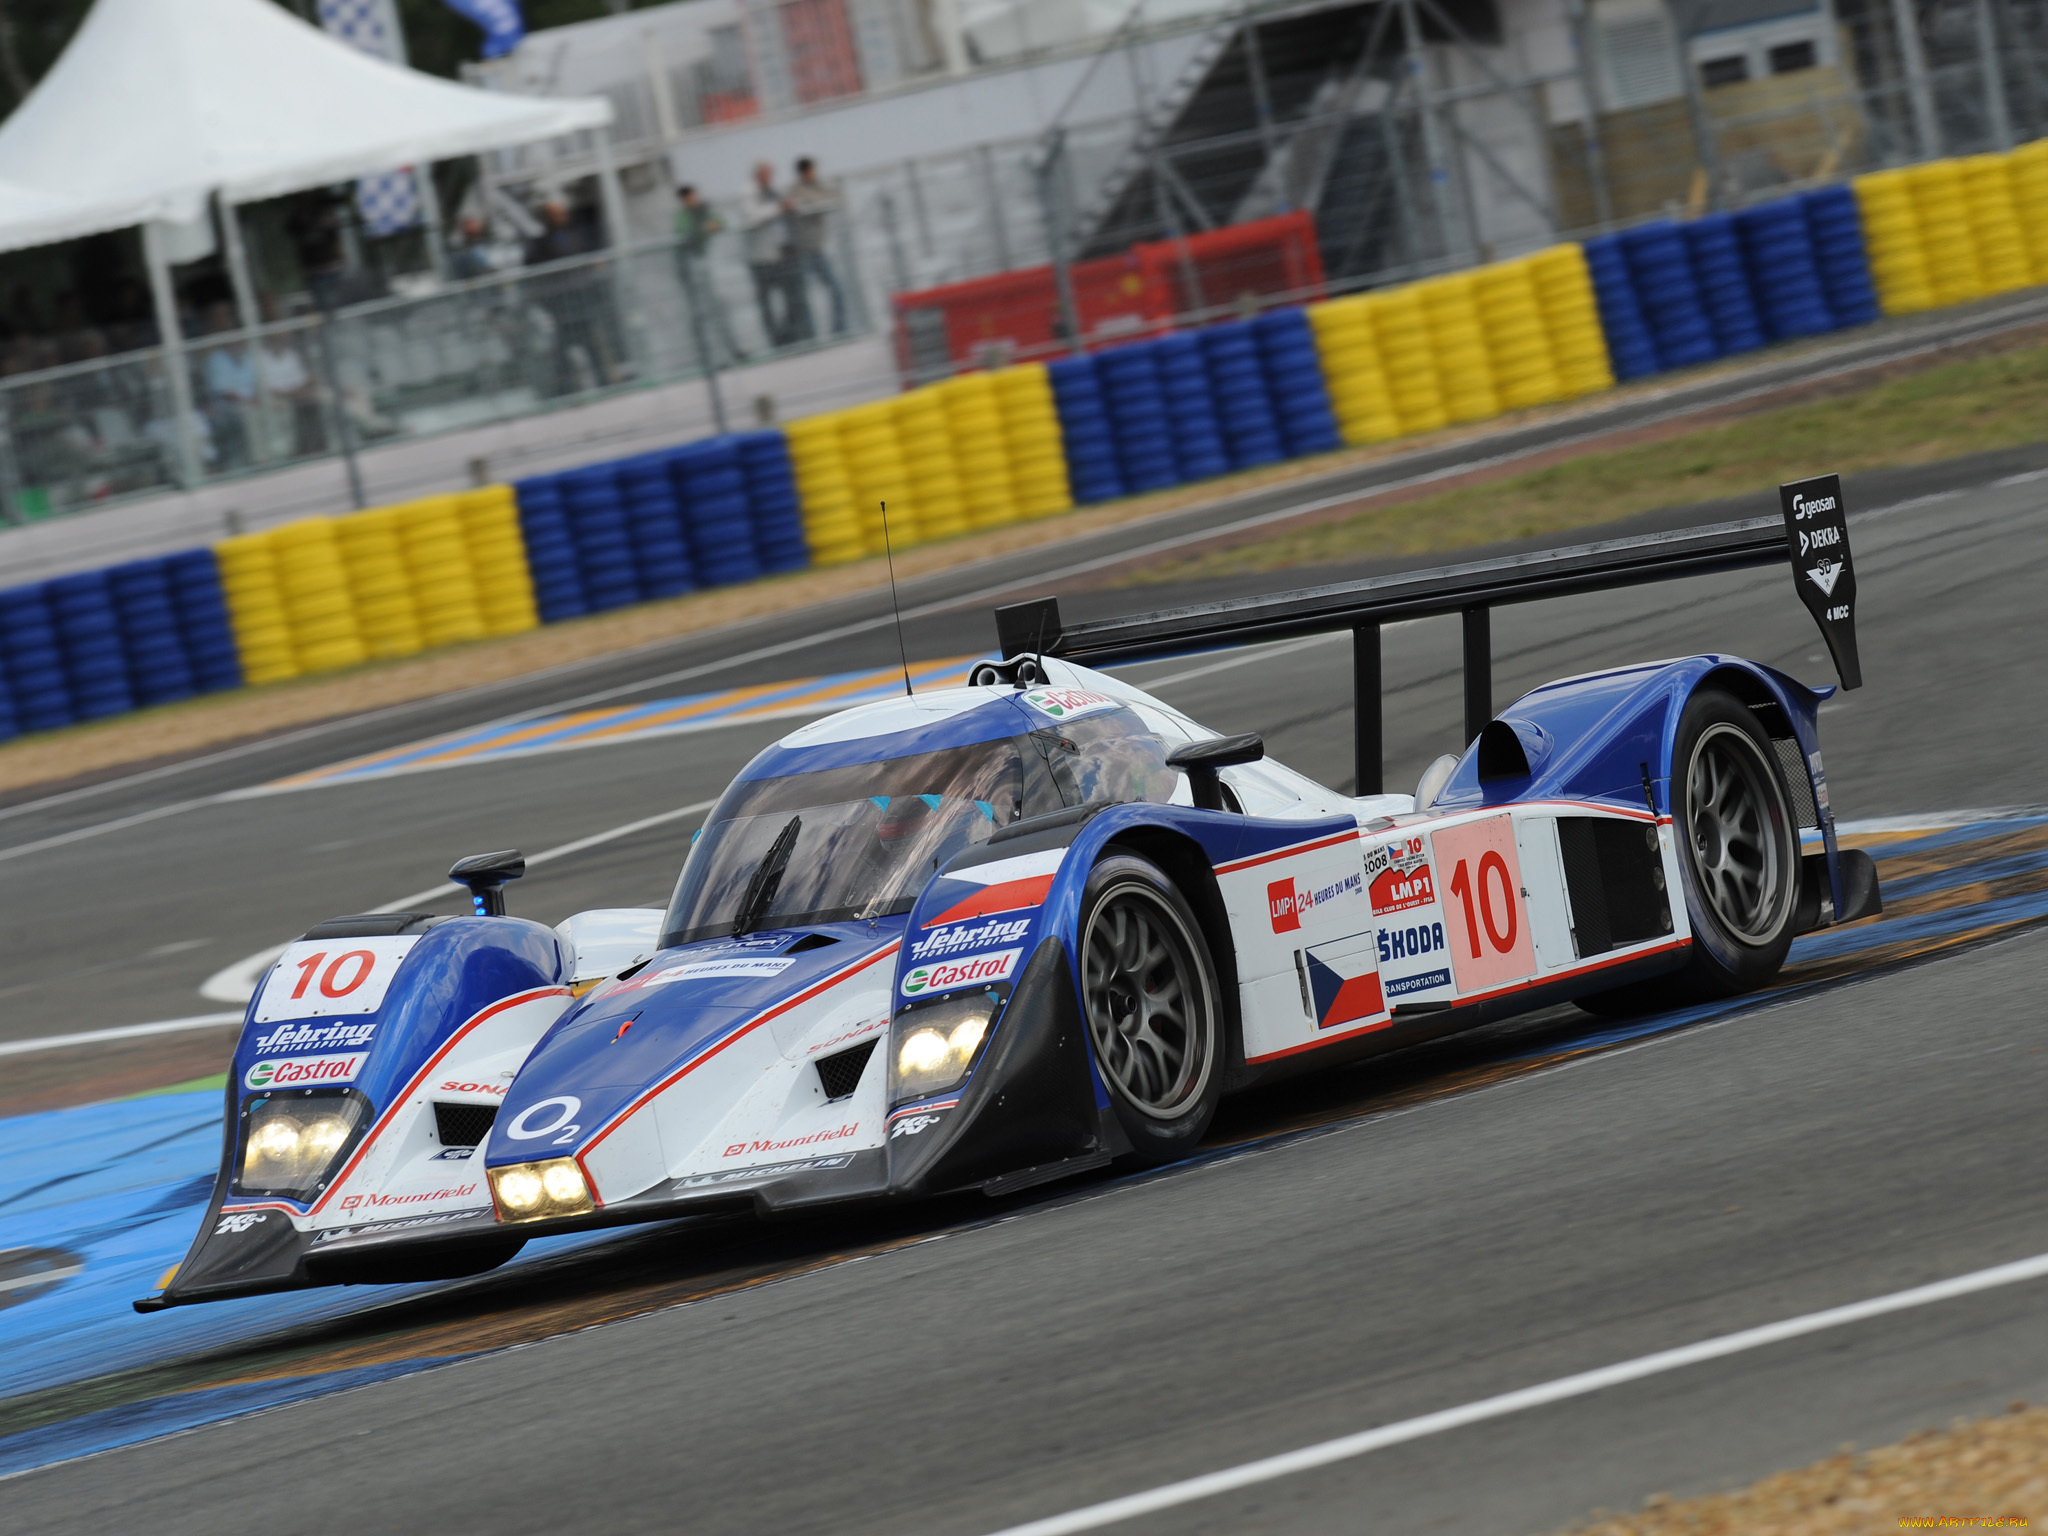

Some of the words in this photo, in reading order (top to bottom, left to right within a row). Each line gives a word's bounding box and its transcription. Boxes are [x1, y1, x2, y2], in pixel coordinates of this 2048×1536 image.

[1806, 496, 1836, 519] geosan
[1810, 526, 1840, 549] DEKRA
[1817, 558, 1832, 576] SD
[1826, 608, 1832, 621] 4
[1833, 605, 1849, 620] MCC
[1374, 846, 1385, 855] MANS
[1407, 837, 1422, 854] 10
[1271, 895, 1295, 918] LMP1
[1297, 889, 1313, 914] 24
[1314, 885, 1335, 905] HEURES
[1335, 881, 1343, 895] DU
[1344, 872, 1361, 891] MANS
[1391, 877, 1430, 901] LMP1
[1384, 905, 1395, 913] CLUB
[1403, 899, 1420, 908] L'OUEST
[1450, 850, 1517, 959] 10
[911, 919, 1031, 954] Sebring
[1377, 922, 1444, 962] ŠKODA
[290, 949, 376, 1000] 10
[684, 964, 729, 975] HEURES
[929, 954, 1011, 987] Castrol
[255, 1021, 377, 1047] Sebring
[274, 1056, 358, 1083] Castrol
[746, 1122, 859, 1153] Mountfield
[720, 1157, 846, 1182] MICHELIN
[363, 1182, 478, 1208] Mountfield
[358, 1210, 481, 1234] MICHELIN
